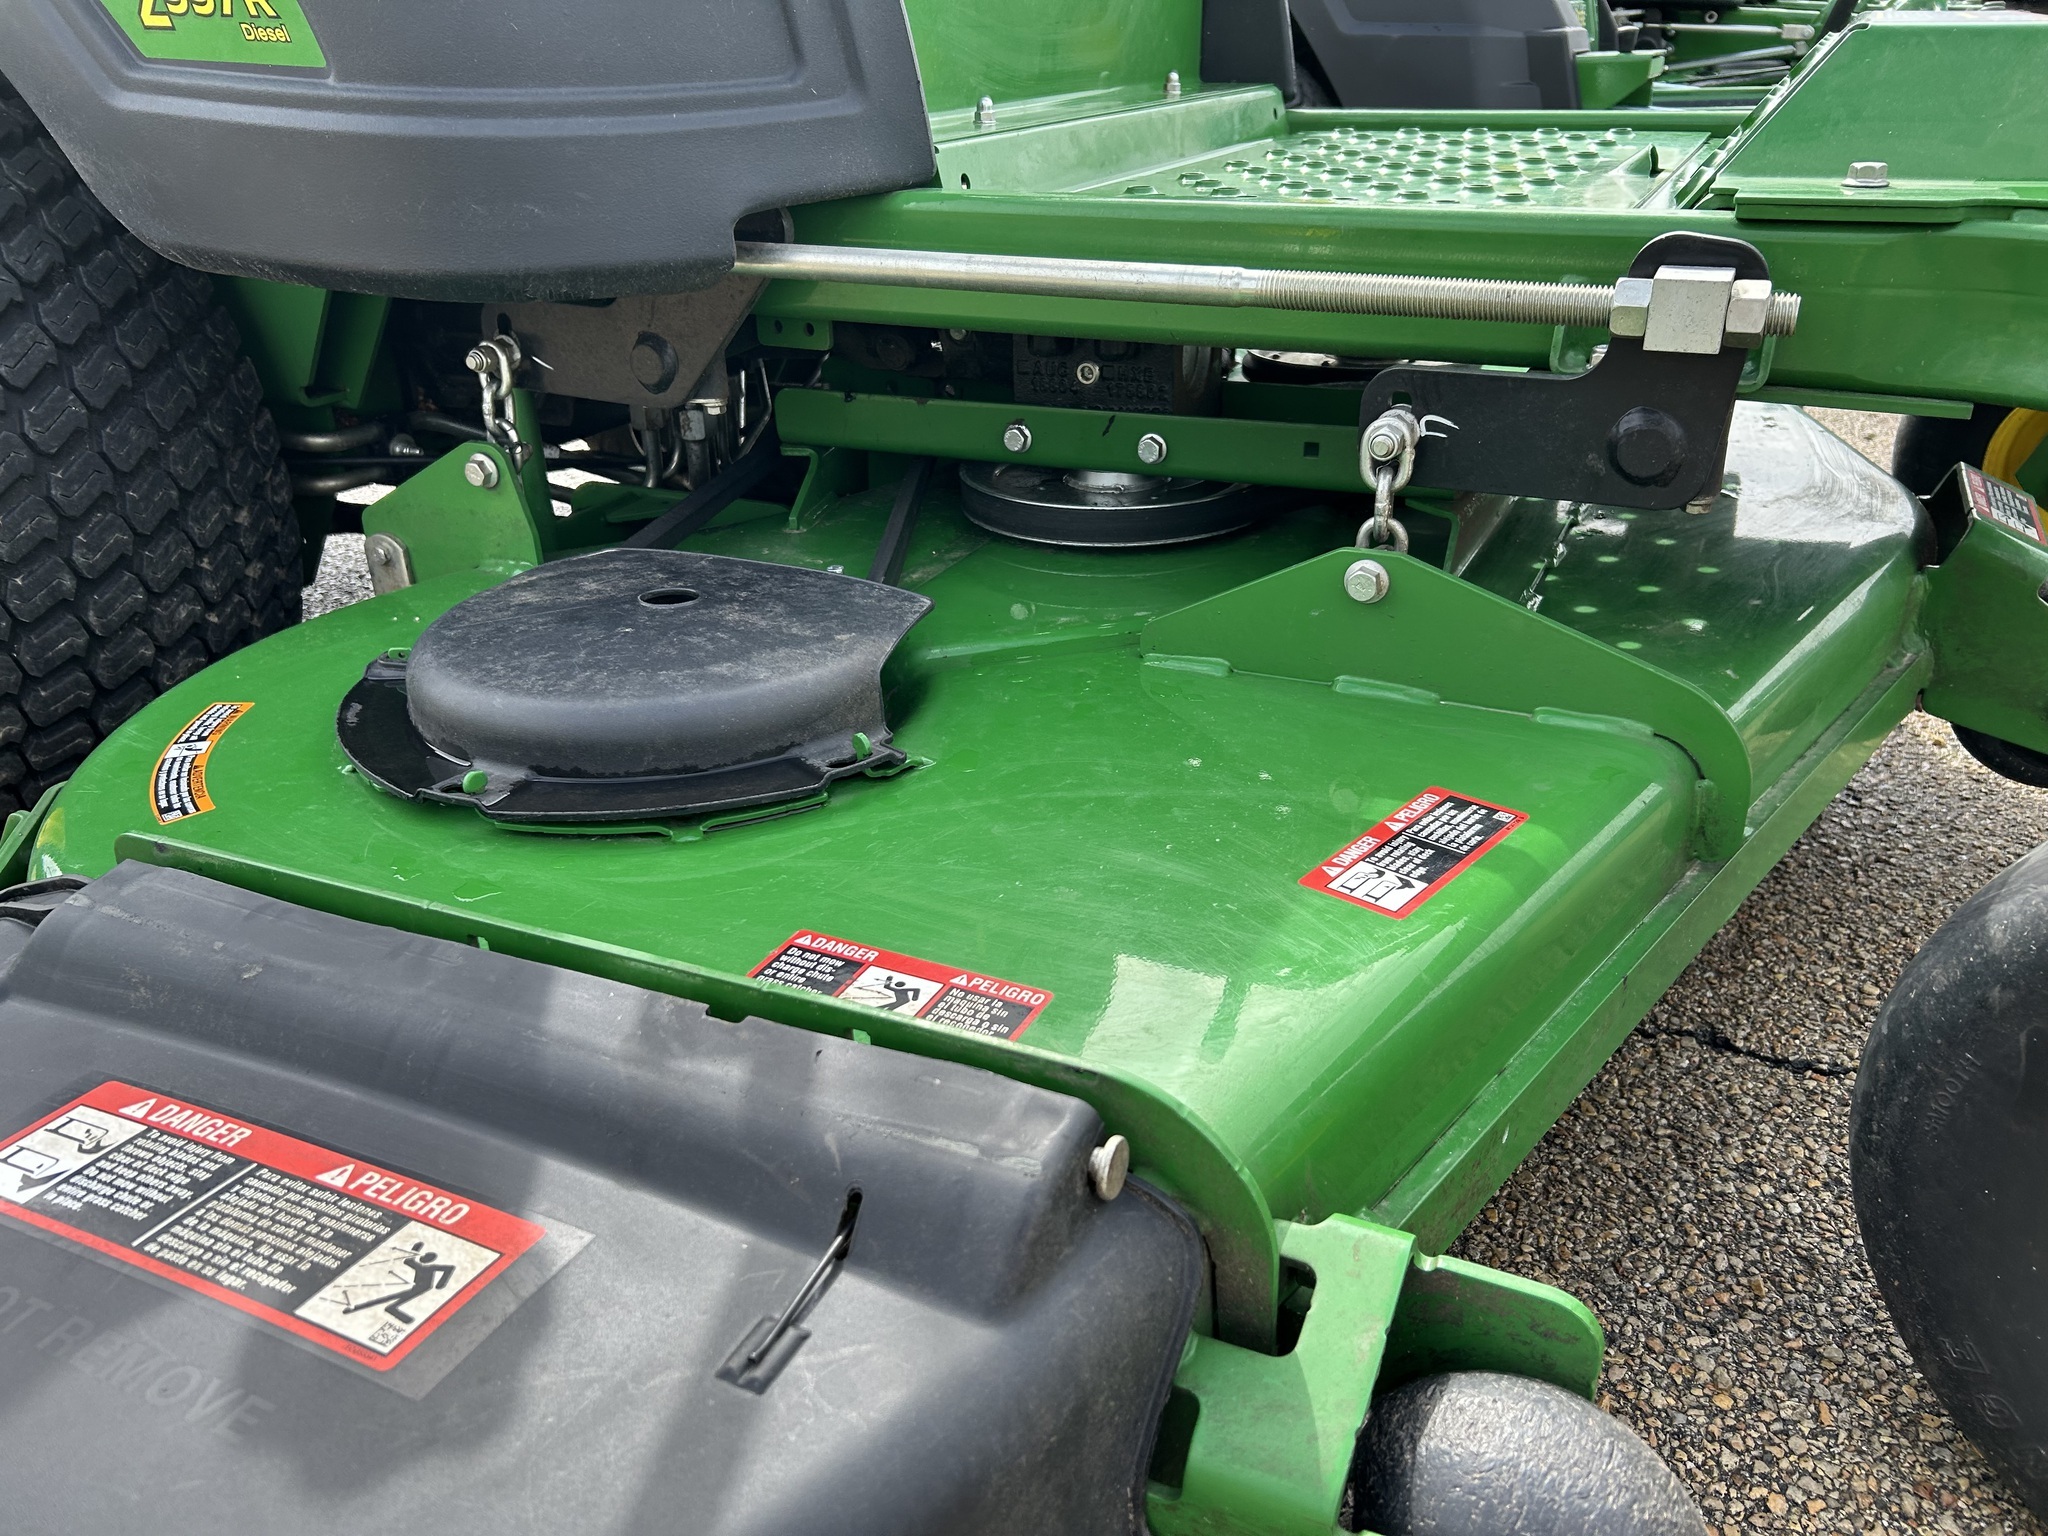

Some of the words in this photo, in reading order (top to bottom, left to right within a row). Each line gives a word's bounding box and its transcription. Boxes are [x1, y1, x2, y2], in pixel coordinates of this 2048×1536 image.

[239, 22, 292, 43] Diesel
[1394, 793, 1440, 822] PELIGRO
[1331, 836, 1381, 866] DANGER
[1374, 845, 1393, 858] avoid
[780, 954, 817, 969] without
[816, 962, 836, 973] dis-
[787, 947, 802, 957] Do
[802, 950, 821, 961] not
[821, 956, 845, 968] mow
[811, 937, 879, 962] DANGER
[763, 968, 778, 976] or
[775, 971, 807, 983] entire
[771, 961, 805, 976] charge
[806, 970, 835, 982] chute
[949, 988, 965, 997] No
[966, 993, 992, 1004] usar
[991, 998, 1004, 1008] la
[968, 977, 1045, 1005] PELIGRO
[925, 1014, 940, 1022] el
[931, 1006, 981, 1026] descarga
[981, 1021, 990, 1029] o
[991, 1023, 1010, 1034] sin
[937, 1001, 951, 1011] el
[950, 1004, 975, 1016] tubo
[975, 1010, 991, 1020] de
[991, 1006, 1009, 1018] sin
[1923, 1052, 1981, 1135] SMOOTH
[148, 1104, 252, 1147] DANGER
[121, 1144, 153, 1159] thrown
[151, 1155, 187, 1173] objects,
[188, 1168, 212, 1181] stay
[133, 1138, 170, 1154] rotating
[168, 1148, 201, 1164] blades
[199, 1160, 222, 1171] and
[146, 1129, 160, 1139] To
[158, 1134, 187, 1147] avoid
[183, 1142, 213, 1157] injury
[210, 1151, 235, 1164] from
[82, 1165, 99, 1177] Do
[96, 1172, 117, 1183] not
[112, 1177, 137, 1190] mow
[135, 1186, 173, 1203] without
[95, 1159, 118, 1170] and
[113, 1164, 138, 1178] keep
[136, 1174, 167, 1189] others
[108, 1152, 134, 1164] clear
[131, 1160, 148, 1169] of
[143, 1164, 168, 1176] deck
[165, 1172, 190, 1185] edge
[43, 1190, 58, 1201] in
[56, 1183, 86, 1198] entire
[81, 1193, 112, 1207] grass
[109, 1202, 147, 1220] catcher
[70, 1175, 115, 1195] discharge
[113, 1191, 142, 1205] chute
[244, 1177, 287, 1196] causadas
[282, 1191, 304, 1202] por
[301, 1198, 344, 1217] cuchillas
[341, 1213, 390, 1234] giratorias
[255, 1168, 281, 1182] Para
[280, 1178, 311, 1192] evitar
[308, 1188, 339, 1202] sufrir
[338, 1198, 382, 1219] lesiones
[348, 1171, 470, 1225] PELIGRO
[206, 1200, 258, 1223] plataforma
[256, 1218, 272, 1228] de
[270, 1223, 297, 1238] corte
[293, 1233, 306, 1242] y
[304, 1236, 351, 1258] mantener
[220, 1192, 258, 1210] alejado
[257, 1205, 279, 1217] del
[275, 1211, 306, 1228] borde
[305, 1223, 321, 1234] de
[320, 1228, 334, 1239] la
[229, 1184, 242, 1192] y
[239, 1187, 275, 1204] objetos
[273, 1199, 316, 1221] lanzados,
[319, 1216, 375, 1241] mantenerse
[182, 1216, 199, 1227] de
[196, 1221, 211, 1231] la
[256, 1244, 274, 1256] No
[272, 1251, 299, 1265] usar
[297, 1260, 311, 1271] la
[194, 1208, 206, 1216] a
[203, 1210, 221, 1222] las
[219, 1217, 253, 1234] demás
[250, 1230, 297, 1251] personas
[295, 1247, 340, 1268] alejadas
[143, 1242, 160, 1253] de
[156, 1248, 188, 1265] pasto
[186, 1259, 203, 1271] en
[200, 1265, 218, 1277] su
[215, 1270, 247, 1290] lugar.
[157, 1233, 203, 1256] descarga
[201, 1251, 213, 1260] o
[210, 1254, 230, 1267] sin
[241, 1267, 296, 1293] recogedor
[212, 1241, 232, 1253] sin
[229, 1248, 246, 1259] el
[242, 1252, 268, 1268] tubo
[265, 1263, 284, 1274] de
[36, 1315, 277, 1444] REMOVE
